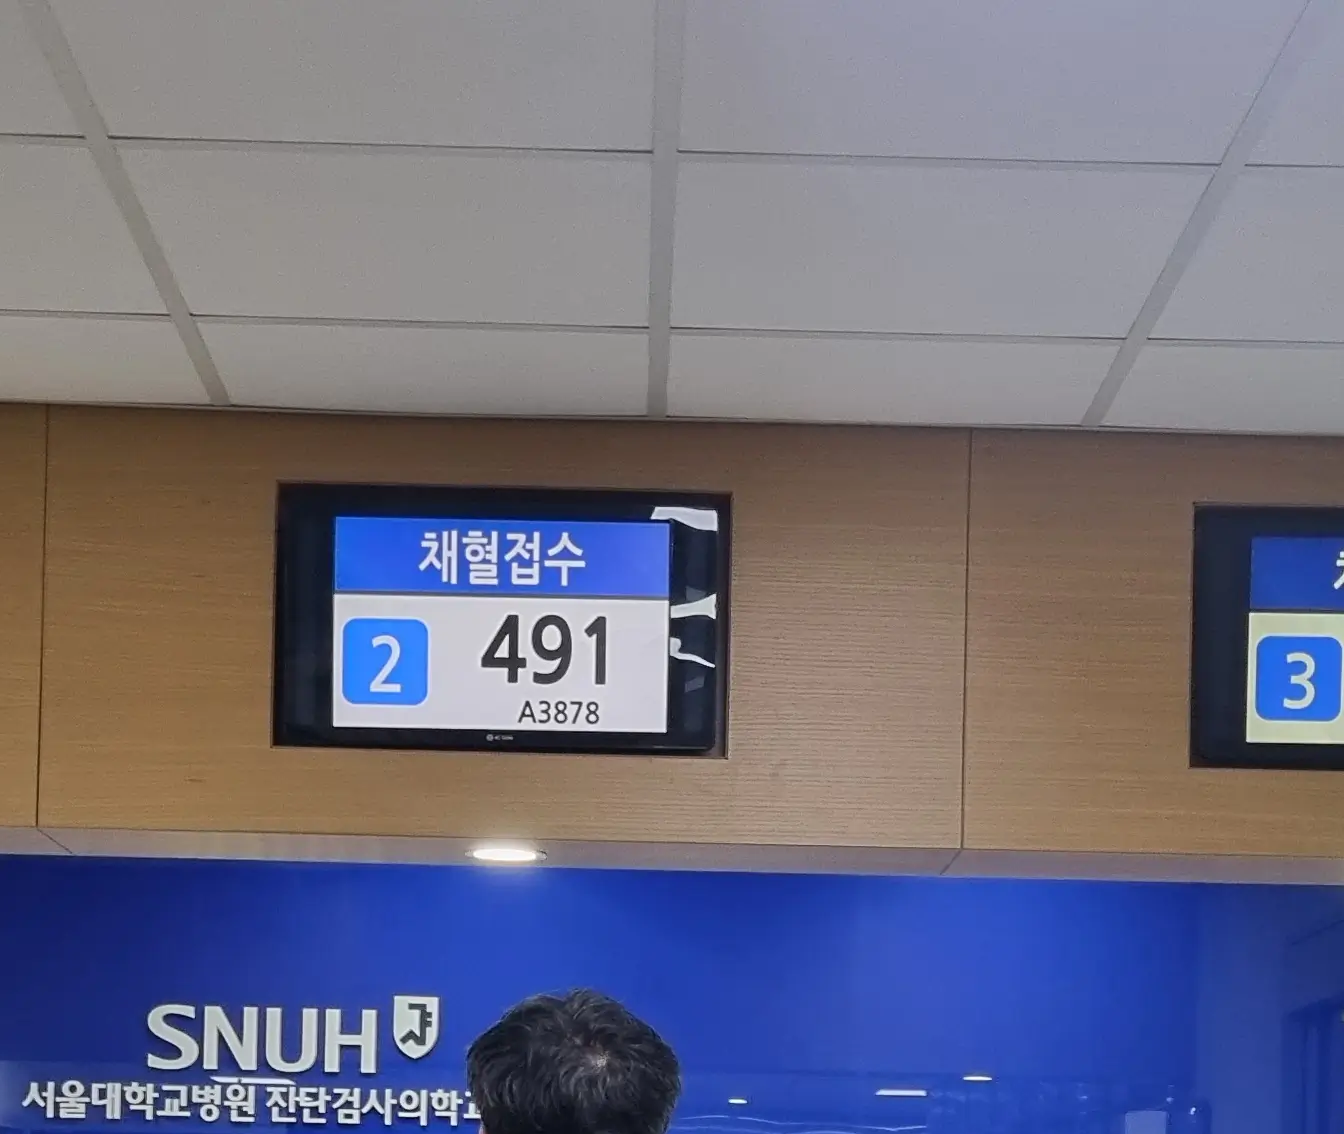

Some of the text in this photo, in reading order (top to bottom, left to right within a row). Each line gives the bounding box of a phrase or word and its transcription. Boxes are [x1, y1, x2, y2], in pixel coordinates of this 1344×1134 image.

[418, 530, 586, 587] 채혈접수
[368, 635, 402, 693] 2
[480, 614, 607, 686] 491
[1282, 652, 1316, 710] 3
[518, 700, 600, 725] A3878
[146, 1003, 378, 1074] SNUH
[22, 1079, 255, 1124] 서울대학교병원
